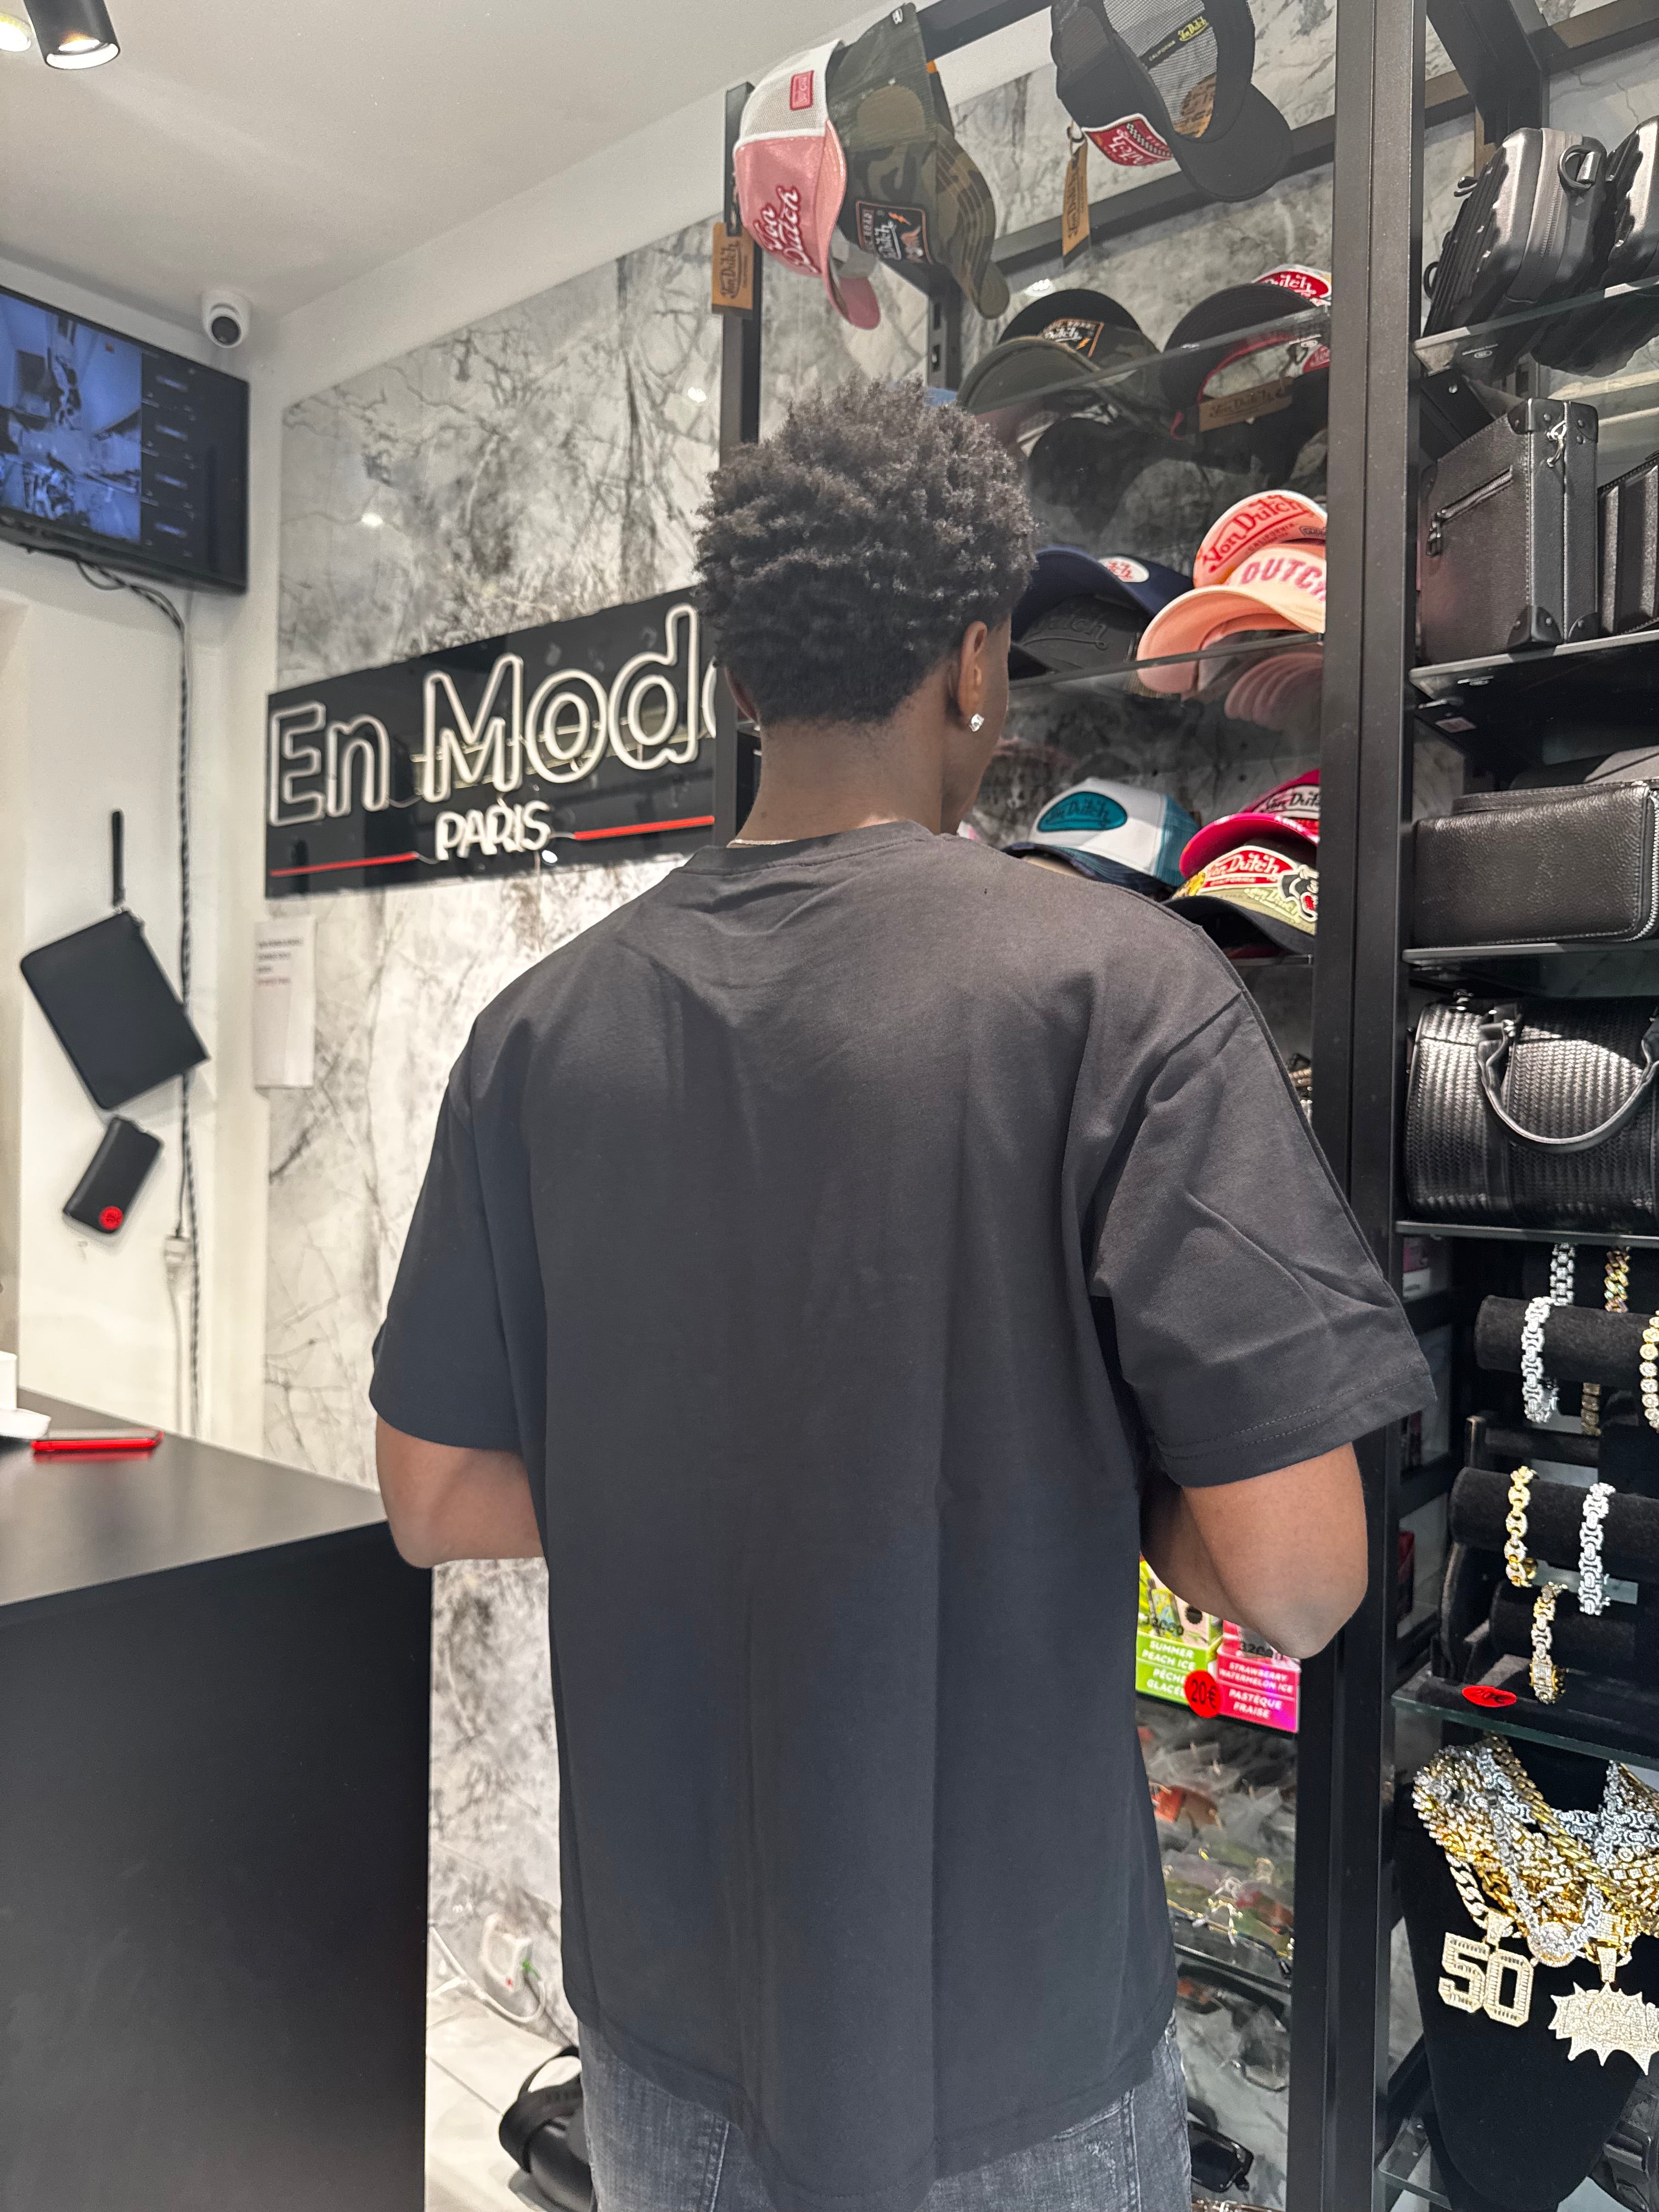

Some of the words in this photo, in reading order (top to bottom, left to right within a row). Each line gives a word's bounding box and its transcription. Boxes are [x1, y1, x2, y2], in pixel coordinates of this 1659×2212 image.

[753, 202, 784, 252] Von
[775, 185, 822, 274] Dutch
[1203, 529, 1247, 565] Von
[1233, 494, 1312, 532] Dutch
[269, 699, 391, 827] En
[422, 602, 717, 803] Mod
[435, 800, 551, 861] PARIS
[1226, 852, 1280, 876] Dutch
[1142, 1649, 1176, 1666] PEACH
[1177, 1658, 1197, 1671] ICE
[1149, 1639, 1194, 1660] SUMMER
[1219, 1668, 1277, 1691] WATERMELON
[1278, 1684, 1294, 1694] ICE
[1229, 1661, 1289, 1682] STRAWBERRY
[1190, 1679, 1217, 1709] 20€
[1233, 1701, 1271, 1719] FRAISE
[1438, 1932, 1534, 2028] 50
